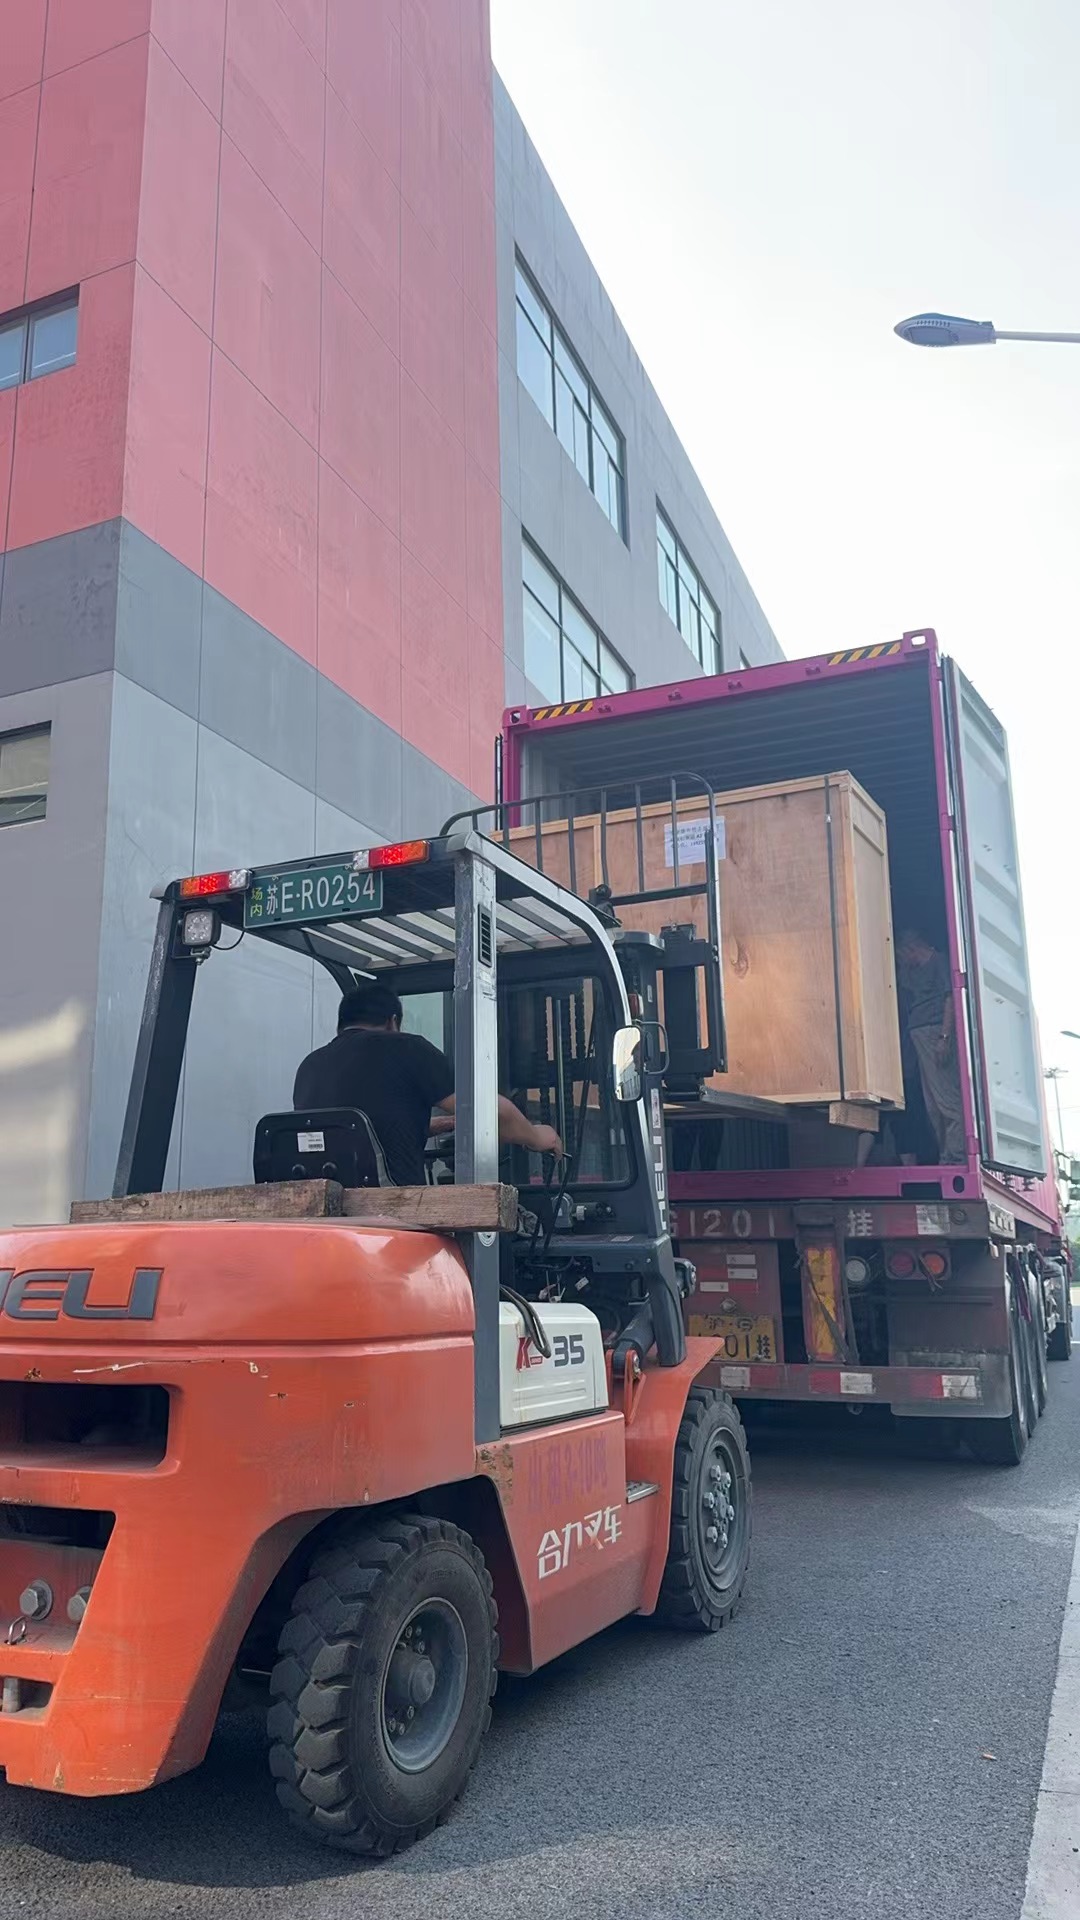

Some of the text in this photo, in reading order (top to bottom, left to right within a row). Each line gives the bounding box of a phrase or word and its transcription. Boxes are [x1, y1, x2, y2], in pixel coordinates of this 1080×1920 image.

[848, 1208, 874, 1238] 挂
[553, 1334, 585, 1368] 35
[537, 1504, 623, 1580] 合力叉车
